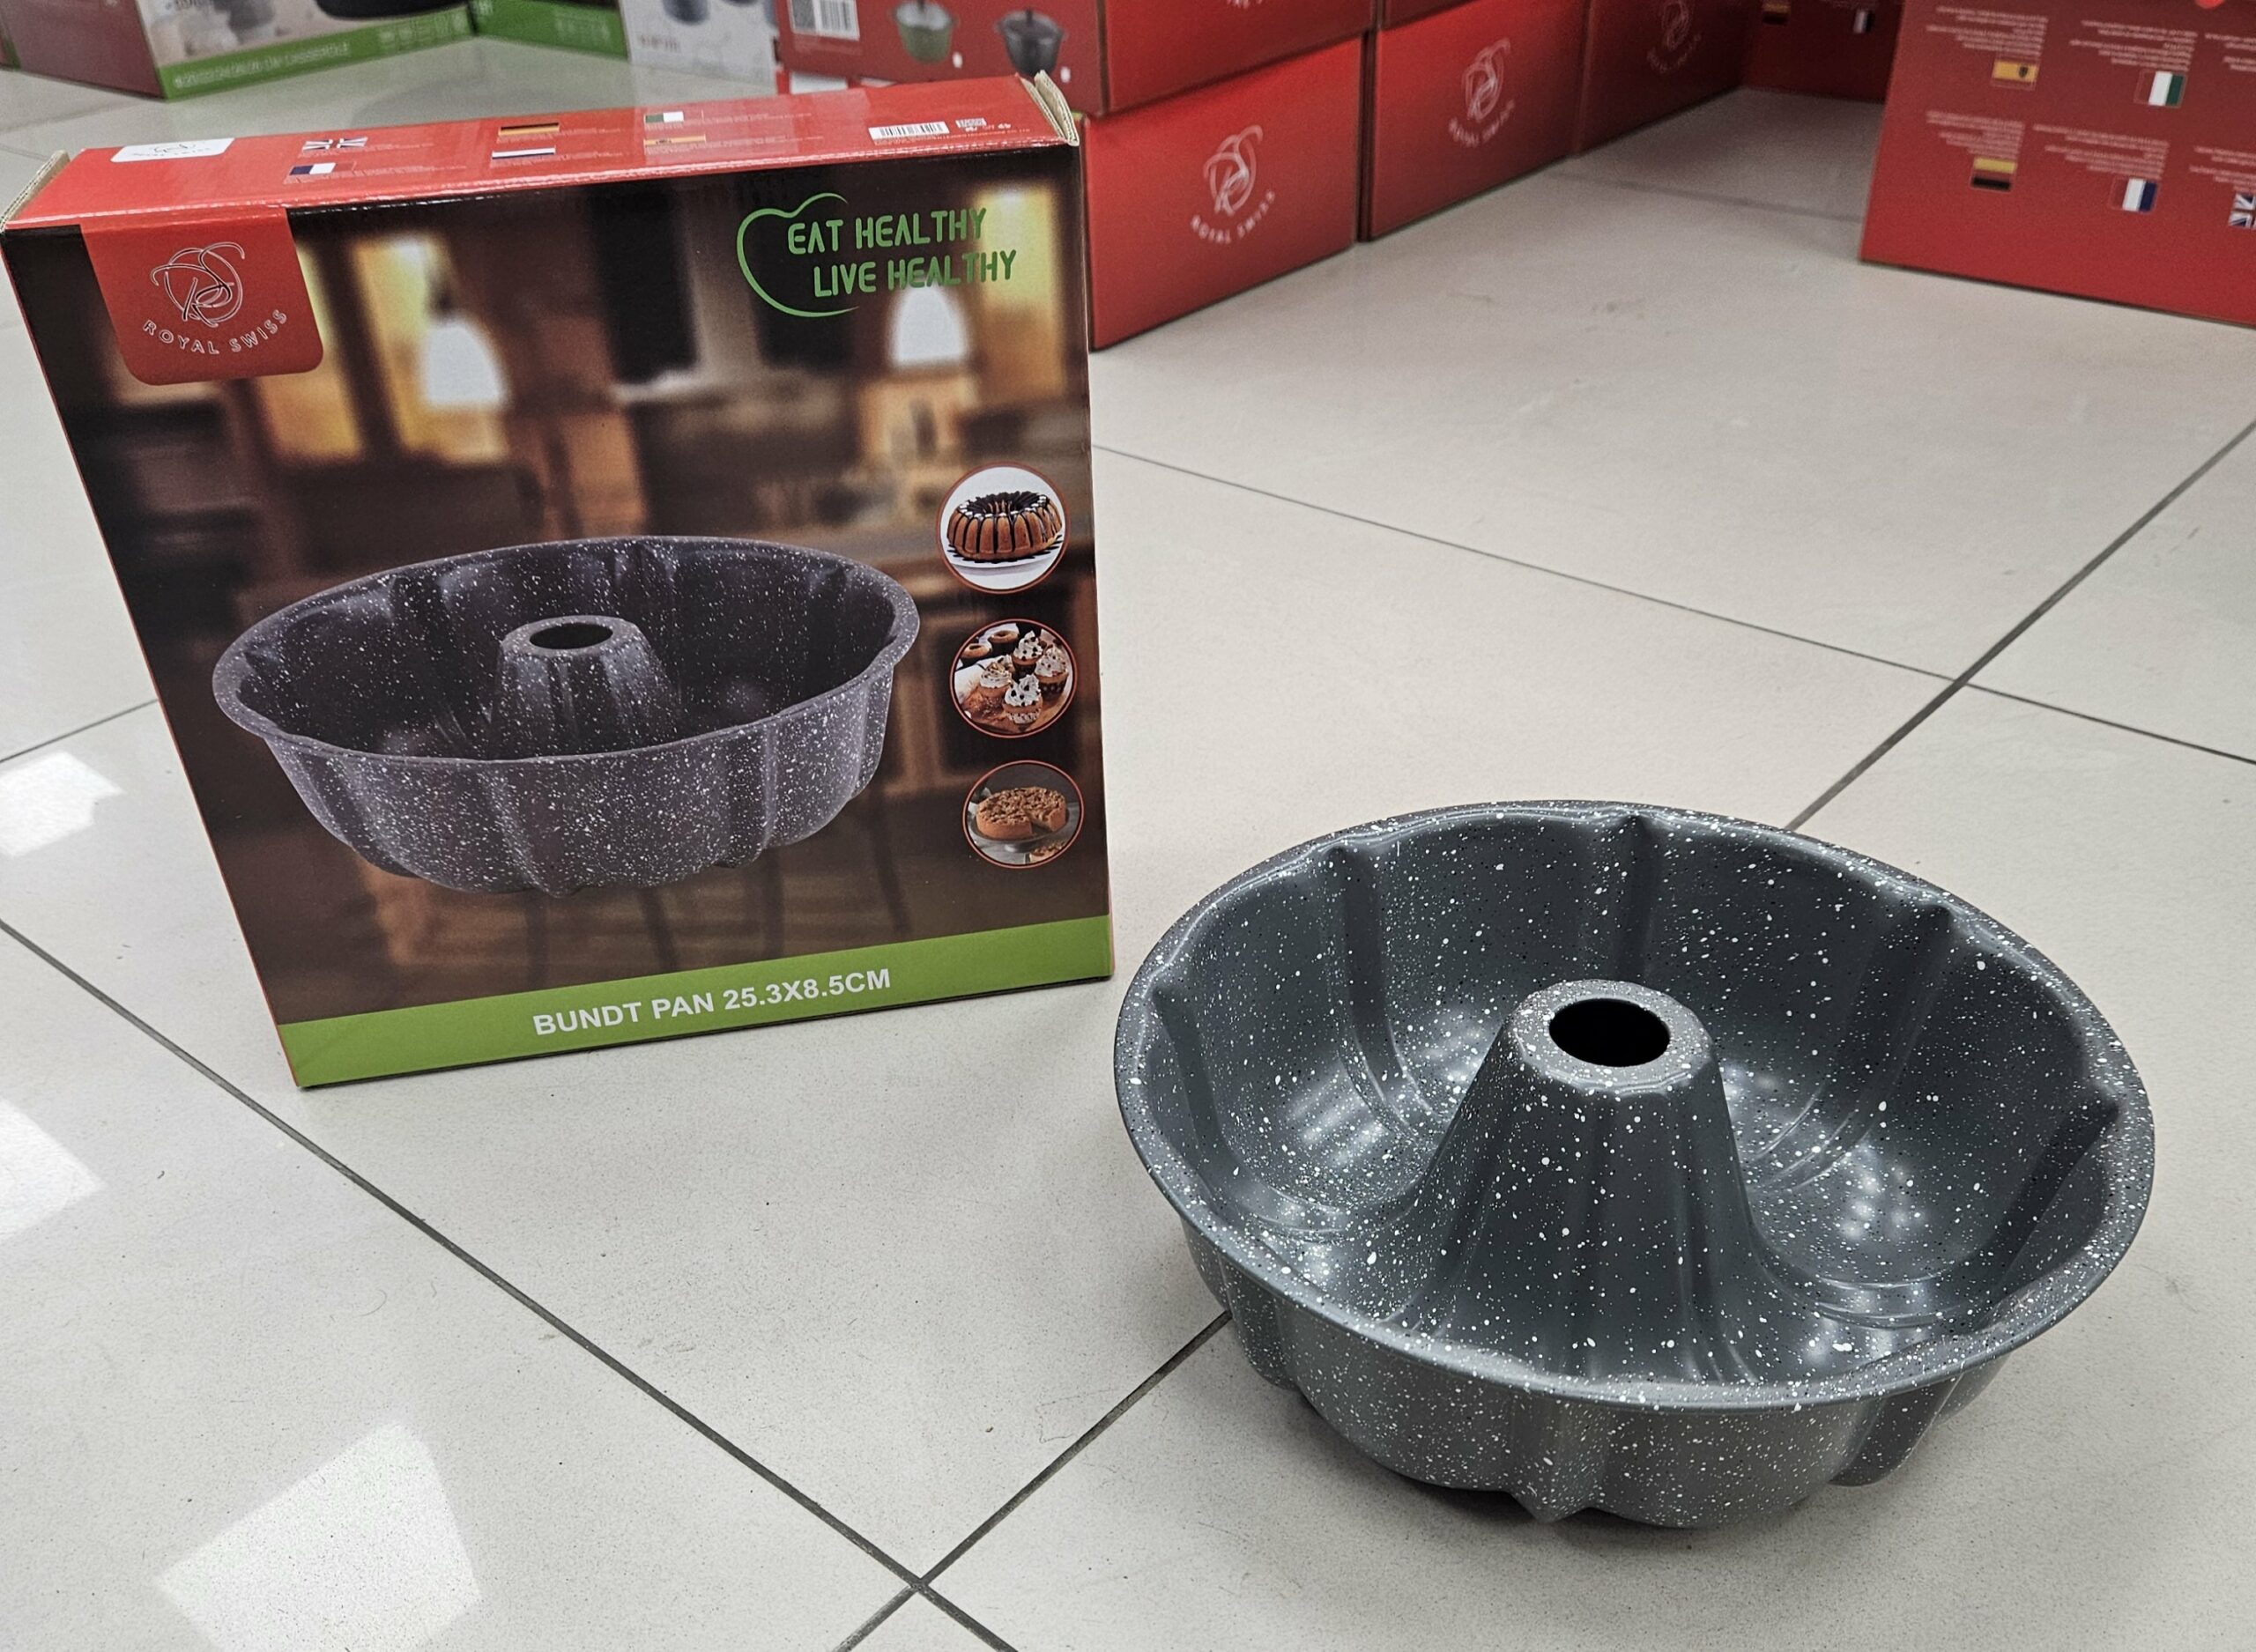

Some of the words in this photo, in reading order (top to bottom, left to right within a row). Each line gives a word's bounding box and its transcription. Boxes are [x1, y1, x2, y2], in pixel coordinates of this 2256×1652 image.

[788, 219, 843, 255] EAT
[855, 207, 987, 249] HEALTHY
[813, 262, 877, 298] LIVE
[887, 248, 1017, 292] HEALTHY
[143, 319, 220, 354] ROYAL
[228, 309, 288, 353] SWISS
[532, 1001, 642, 1036] BUNDT
[651, 992, 715, 1019] PAN
[723, 968, 891, 1011] 25.3X8.5CM
